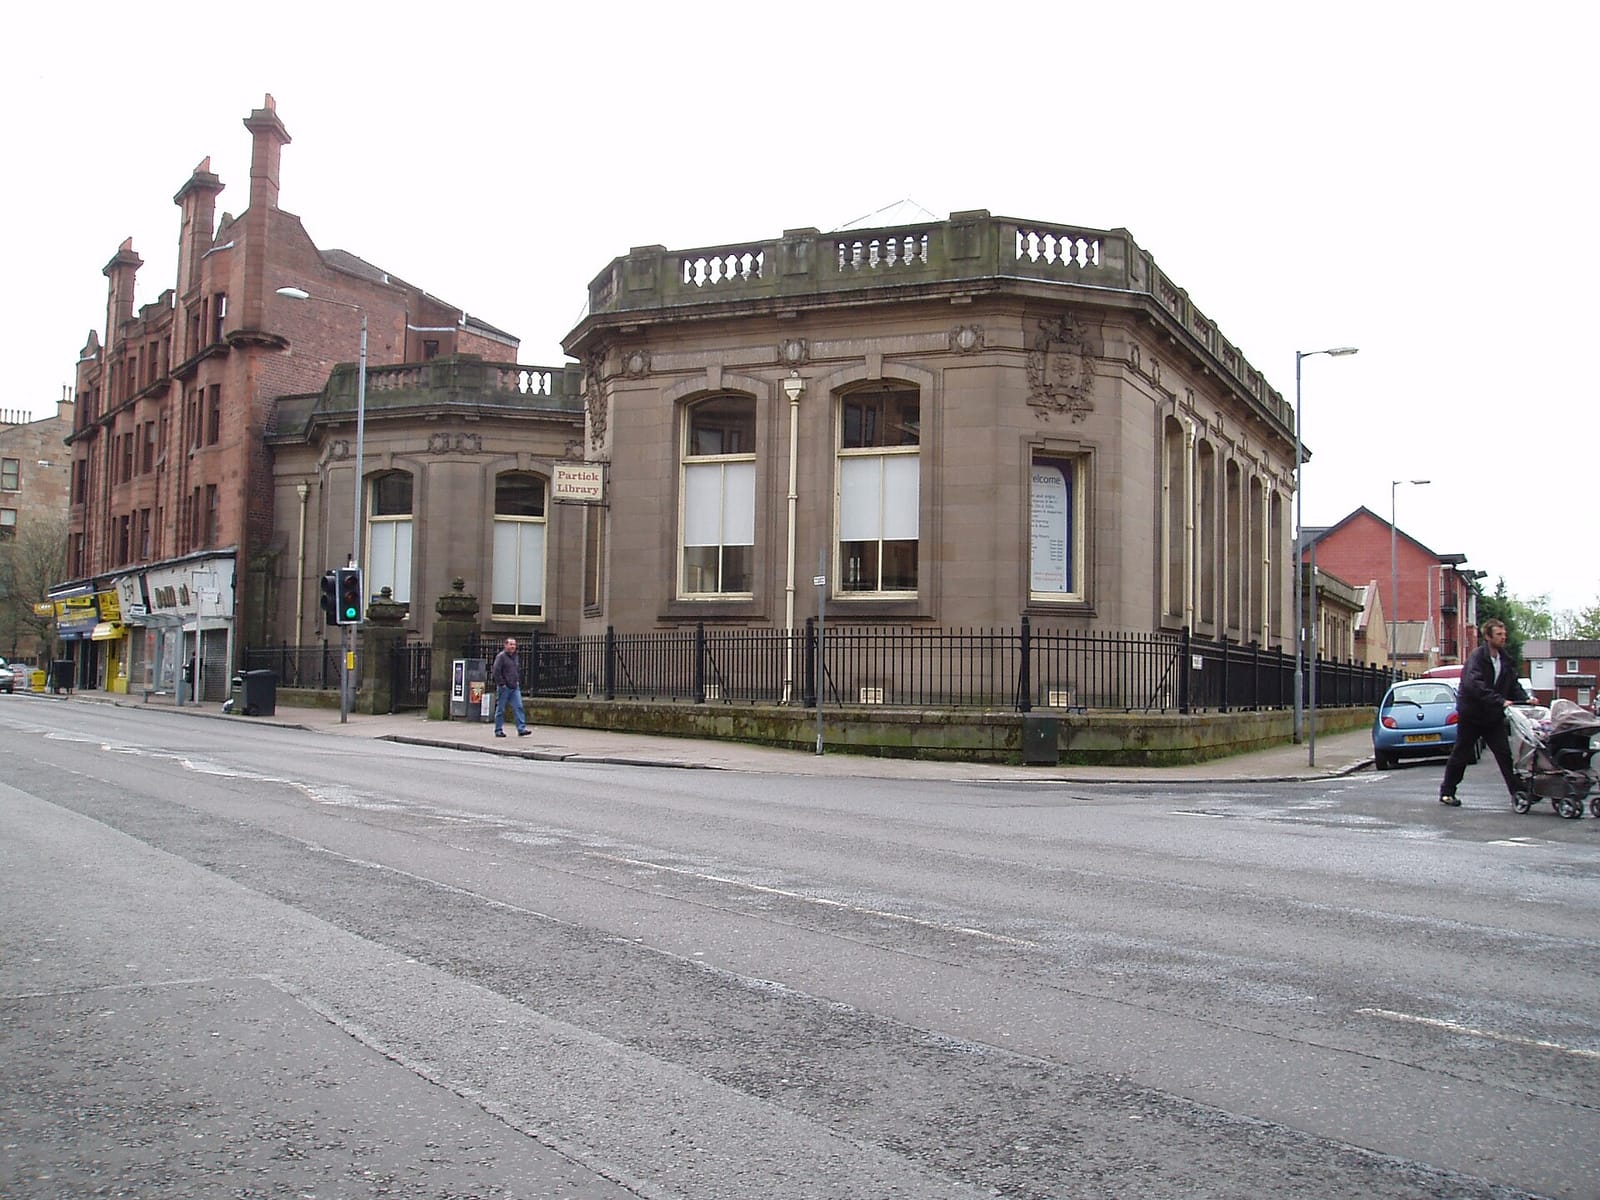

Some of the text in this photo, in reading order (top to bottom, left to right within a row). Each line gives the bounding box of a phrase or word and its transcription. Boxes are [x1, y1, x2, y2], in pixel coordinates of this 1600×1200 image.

[558, 470, 599, 480] Partick
[1032, 474, 1061, 485] elcome
[558, 484, 599, 495] Library
